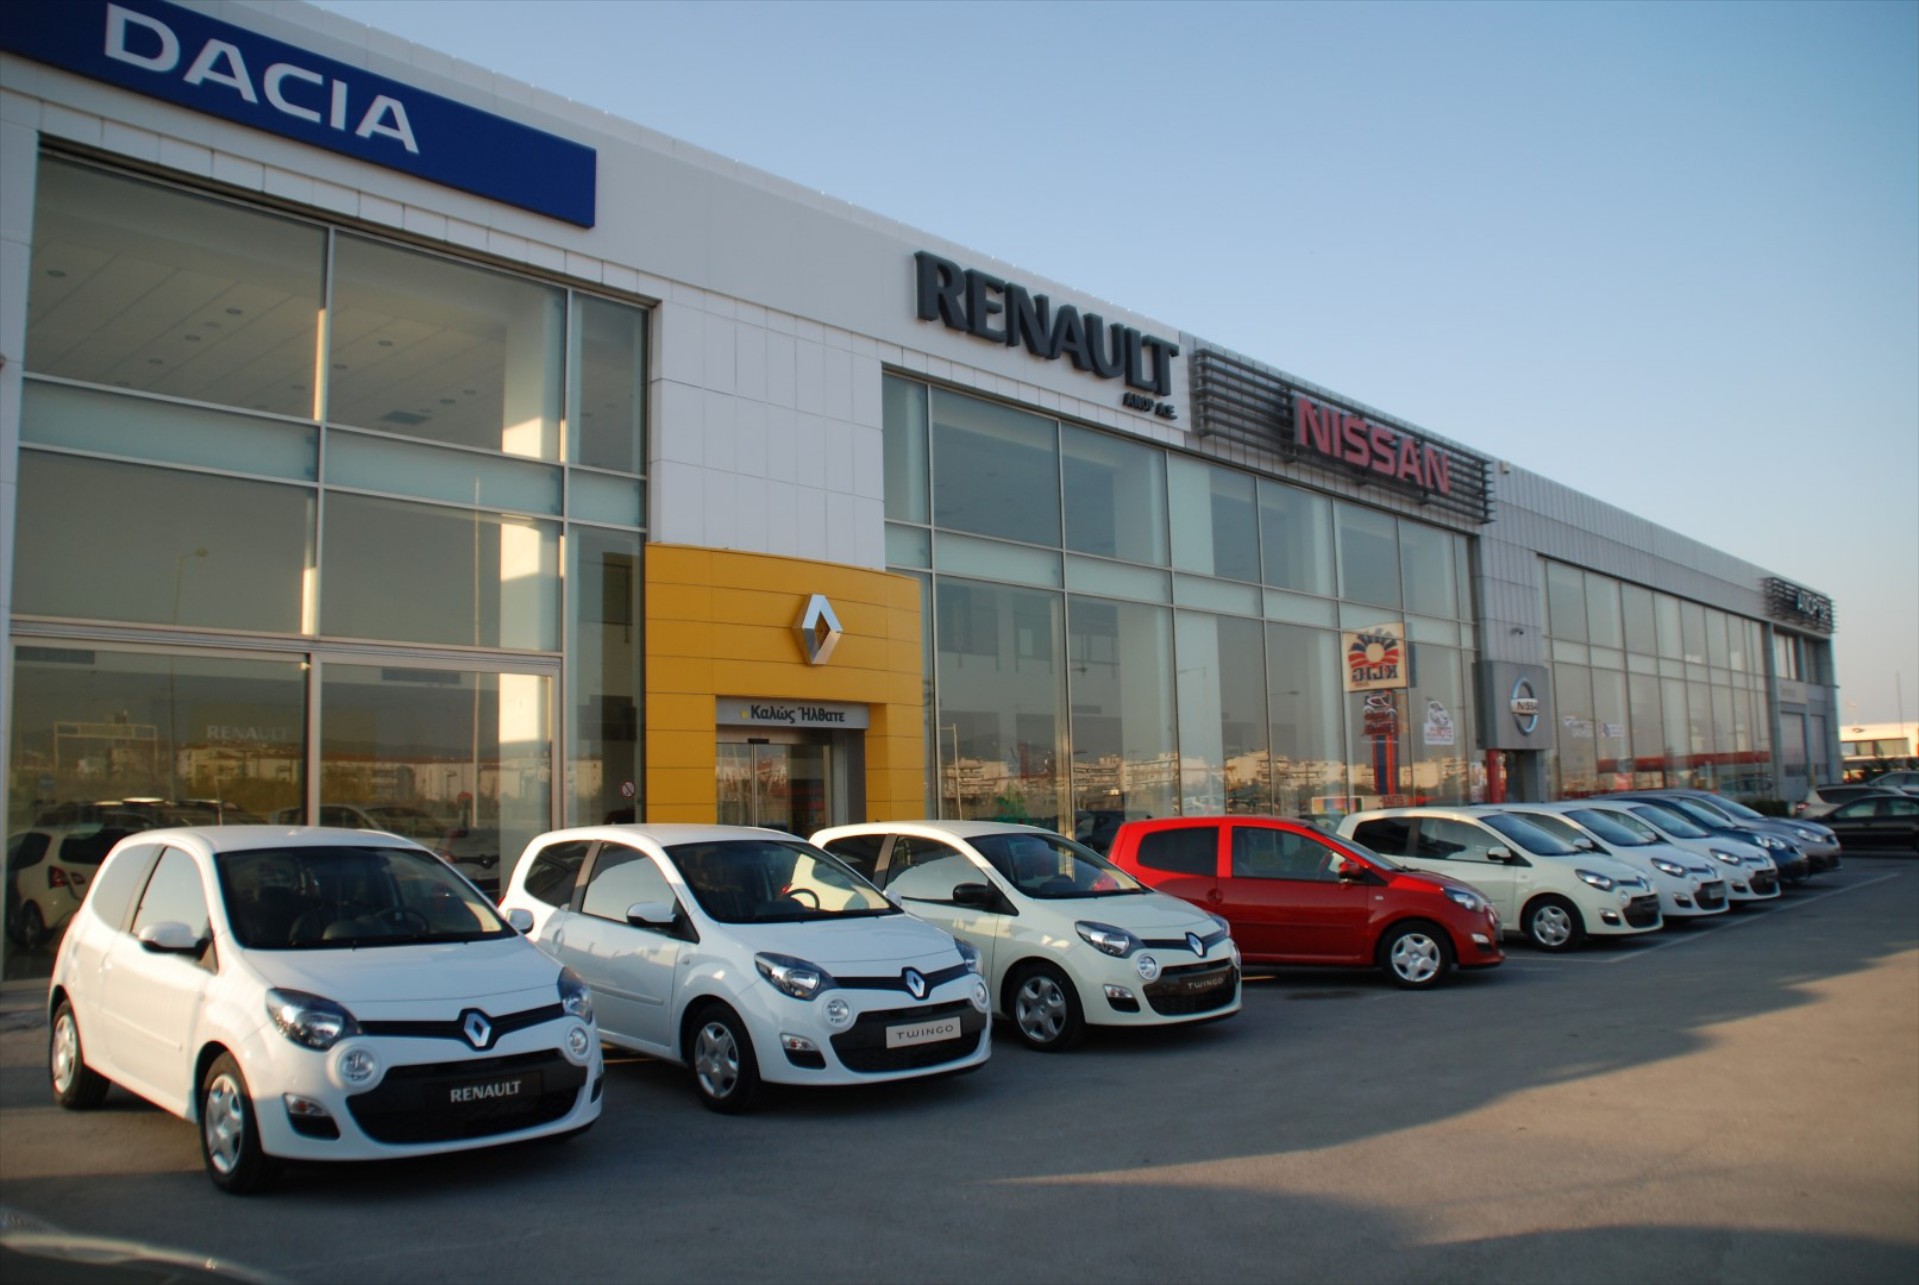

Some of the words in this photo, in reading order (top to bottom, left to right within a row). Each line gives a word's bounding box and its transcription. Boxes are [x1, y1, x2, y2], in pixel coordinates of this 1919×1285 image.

[104, 2, 420, 155] DACIA
[914, 250, 1180, 396] RENAULT
[1293, 395, 1451, 495] NISSAN
[206, 724, 287, 741] RENAULT
[1187, 977, 1224, 990] TWINGO
[896, 1024, 954, 1040] TWINGO
[450, 1080, 522, 1102] RENAULT
